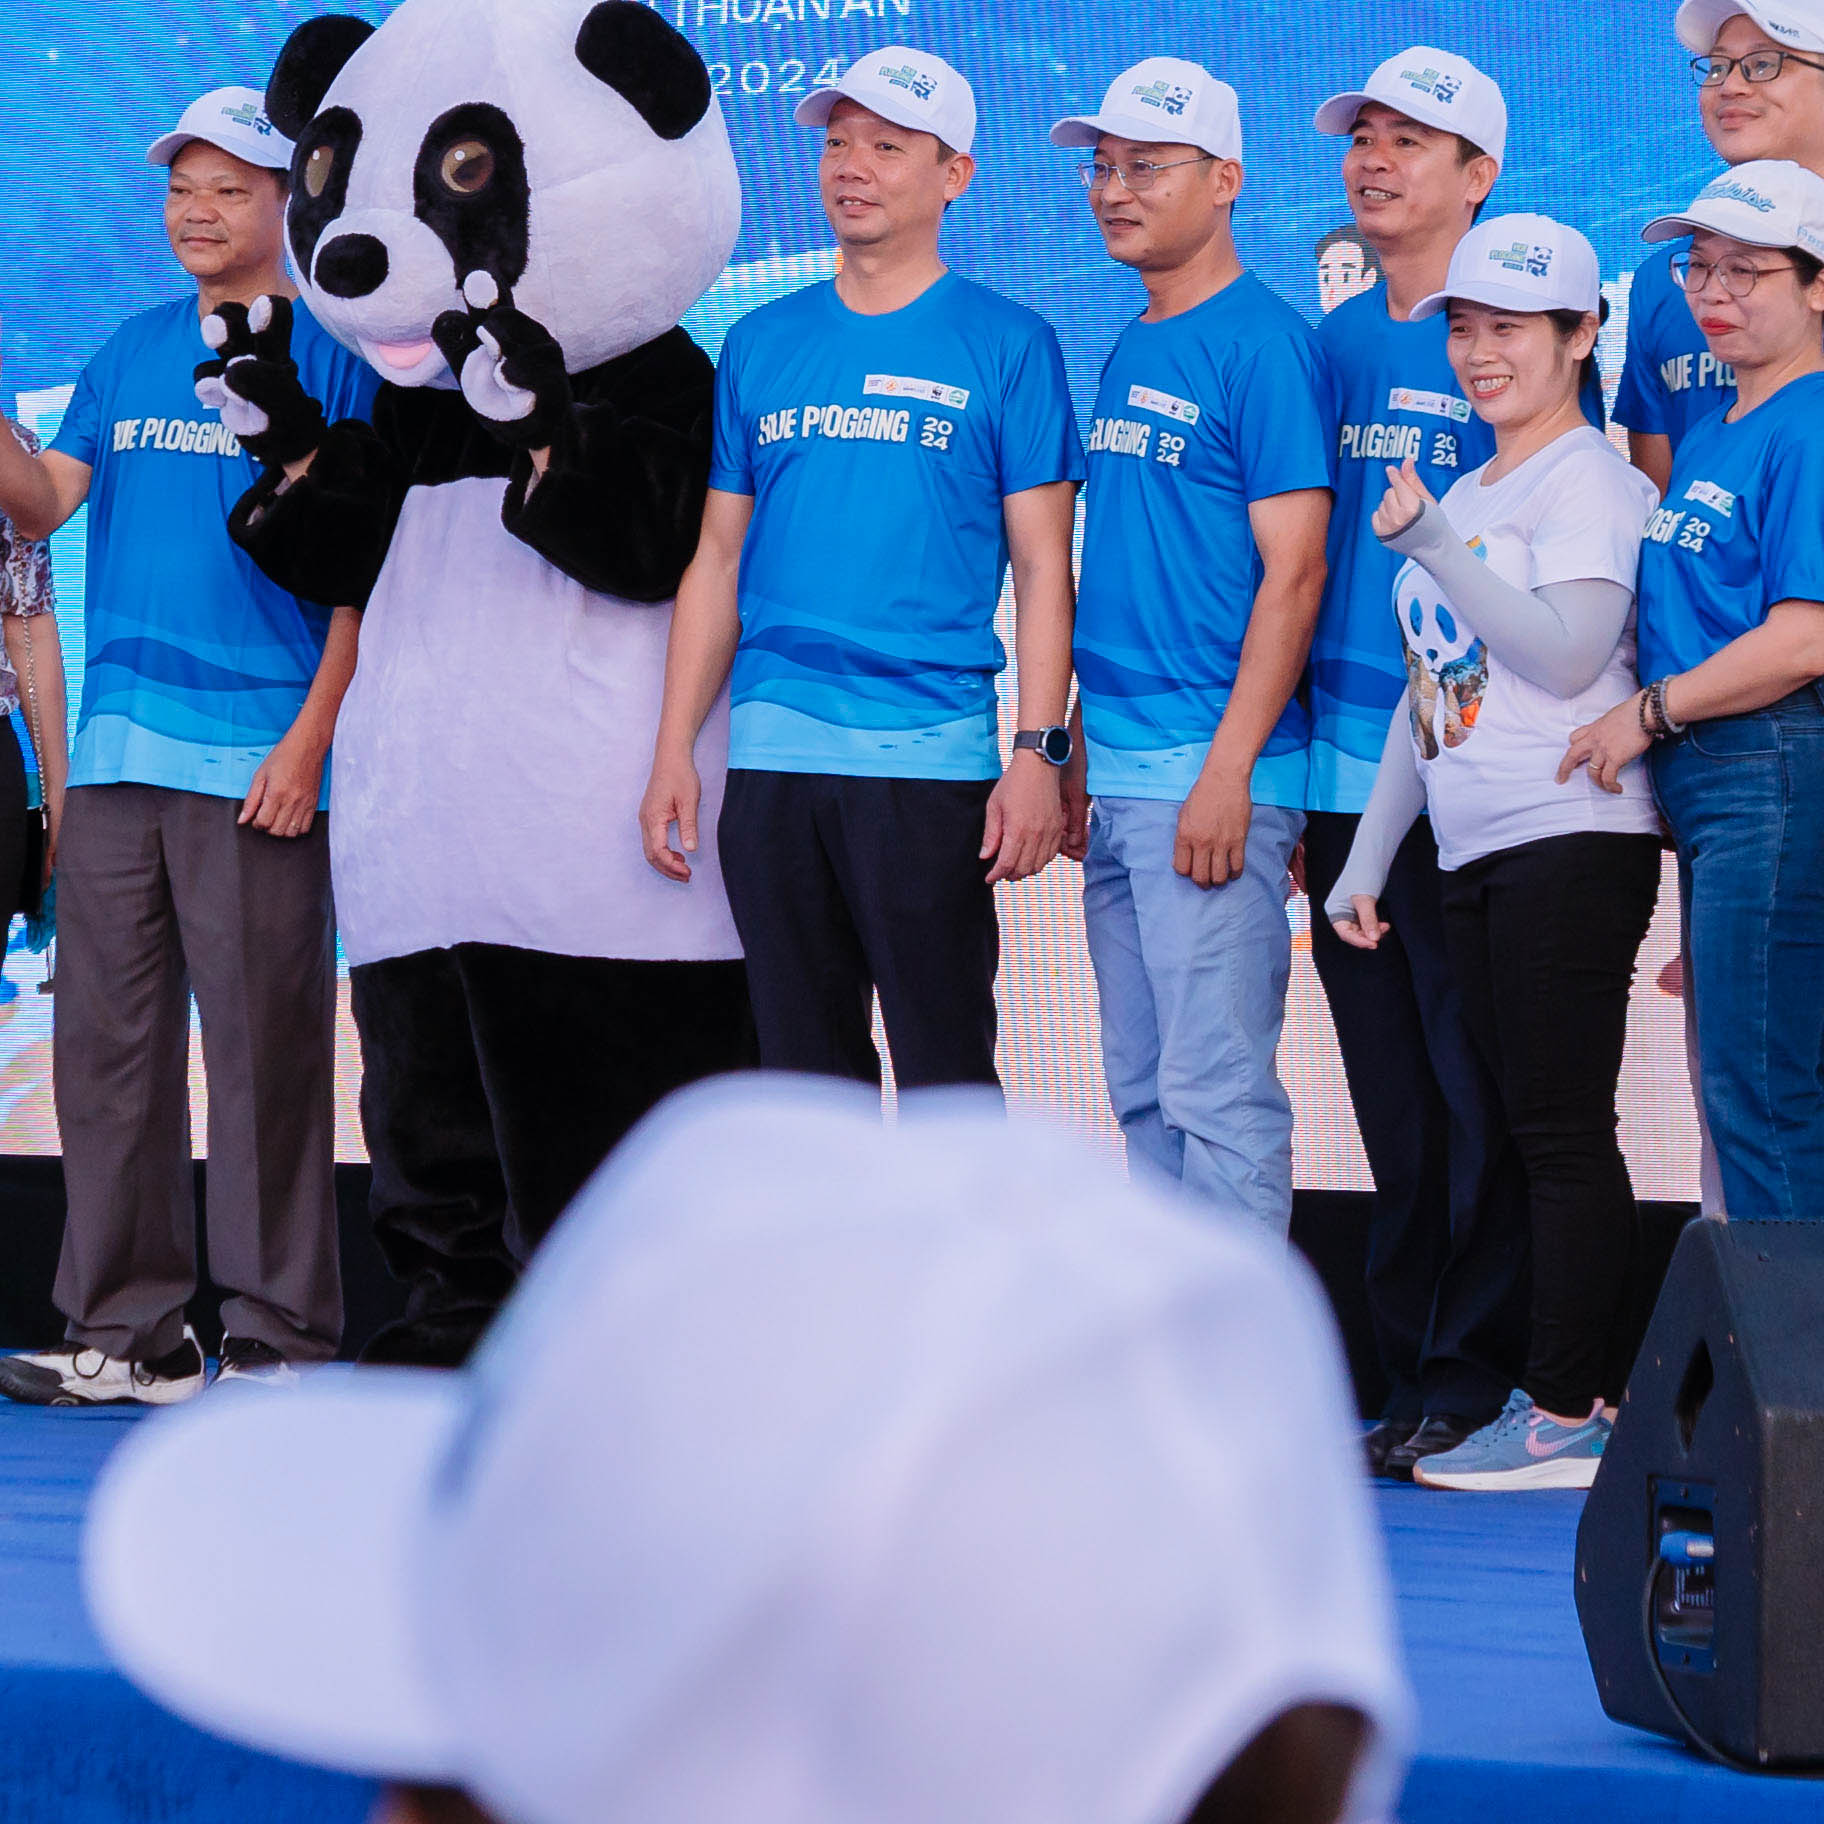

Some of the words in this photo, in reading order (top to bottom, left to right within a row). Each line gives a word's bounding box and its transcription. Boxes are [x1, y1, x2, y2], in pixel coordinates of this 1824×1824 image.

[923, 416, 953, 436] 20
[920, 431, 949, 451] 24
[1158, 431, 1186, 452] 20
[1433, 432, 1457, 452] 20
[1156, 447, 1181, 467] 24
[1430, 449, 1458, 468] 24
[1684, 517, 1711, 537] 20
[1678, 531, 1705, 553] 24
